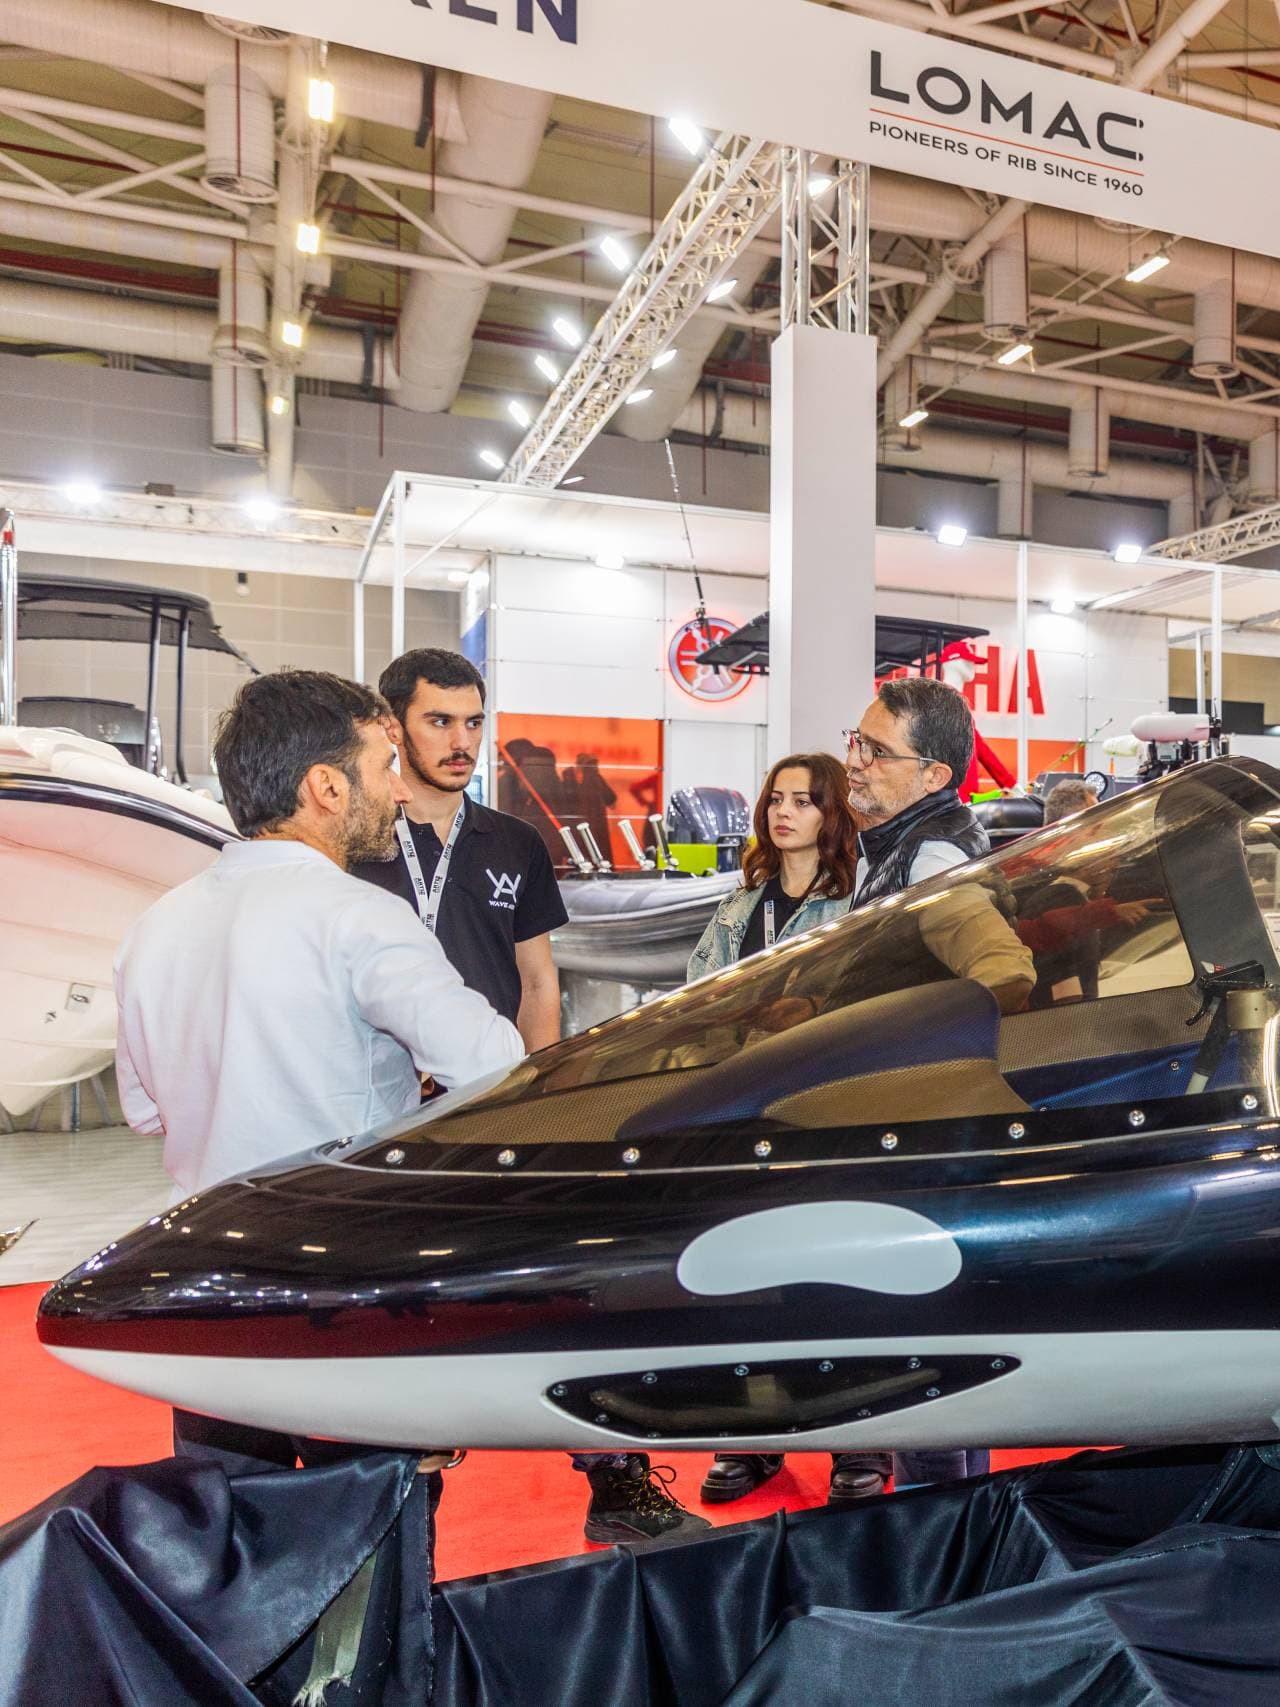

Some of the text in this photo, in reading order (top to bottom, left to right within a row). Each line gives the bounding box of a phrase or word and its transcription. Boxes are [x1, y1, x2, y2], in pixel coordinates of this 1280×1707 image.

[870, 49, 1144, 162] LOMAC
[869, 120, 1144, 197] PIONEERS OF RIB SINCE 1960
